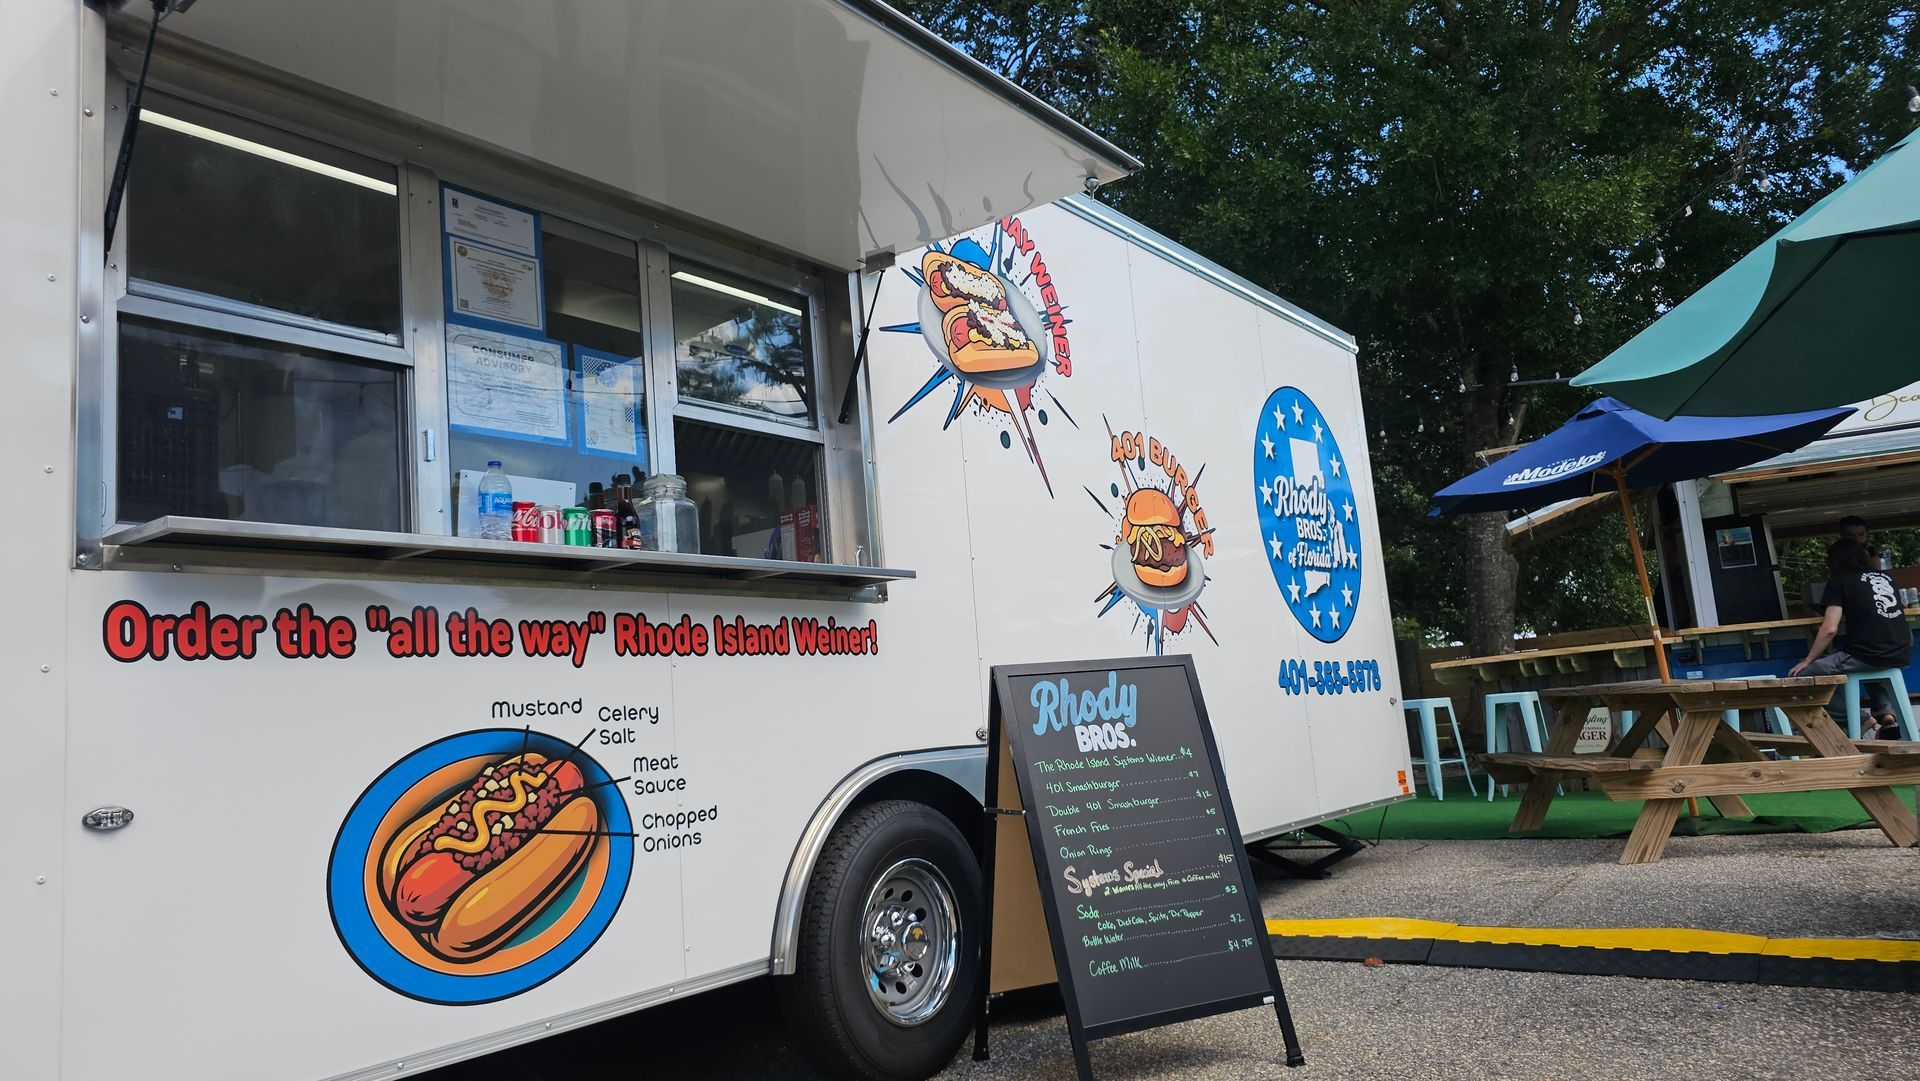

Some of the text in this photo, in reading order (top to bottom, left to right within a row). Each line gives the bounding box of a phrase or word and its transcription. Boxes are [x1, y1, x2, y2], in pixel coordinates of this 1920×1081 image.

[1030, 251, 1072, 378] WEINER
[472, 345, 535, 362] CONSUMER
[476, 357, 533, 373] ADVISORY
[1517, 454, 1598, 480] Modelo
[1111, 431, 1215, 561] 401 BURGER
[1273, 474, 1328, 525] Rhody
[1287, 541, 1333, 568] of Florida
[103, 599, 879, 669] Order the "all the way" Rhode Island Weiner!
[491, 697, 583, 719] Mustard
[598, 705, 660, 725] Celery
[1030, 670, 1138, 736] Rhody
[599, 727, 636, 745] Salt
[1074, 722, 1137, 753] BROS.
[633, 754, 680, 773] Meat
[1034, 761, 1055, 774] The
[1056, 758, 1084, 772] Rhode
[1087, 756, 1110, 769] Island
[1114, 755, 1145, 769] Systems
[1179, 746, 1193, 758] $4
[634, 777, 687, 796] Sauce
[1045, 770, 1200, 794] 401 Smashburger $7
[1045, 790, 1212, 818] Double 401 Smashburger $12
[642, 805, 718, 831] Chopped
[1053, 824, 1087, 837] French
[1090, 821, 1110, 833] Fries
[643, 832, 702, 853] Onions
[1060, 827, 1227, 859] Onion Rings $7
[1063, 854, 1235, 897] Systems Special $15
[1076, 885, 1238, 920] Soda $3
[1104, 886, 1110, 896] 2
[1229, 913, 1246, 923] $2
[1088, 937, 1253, 978] Coffee Milk $4.75
